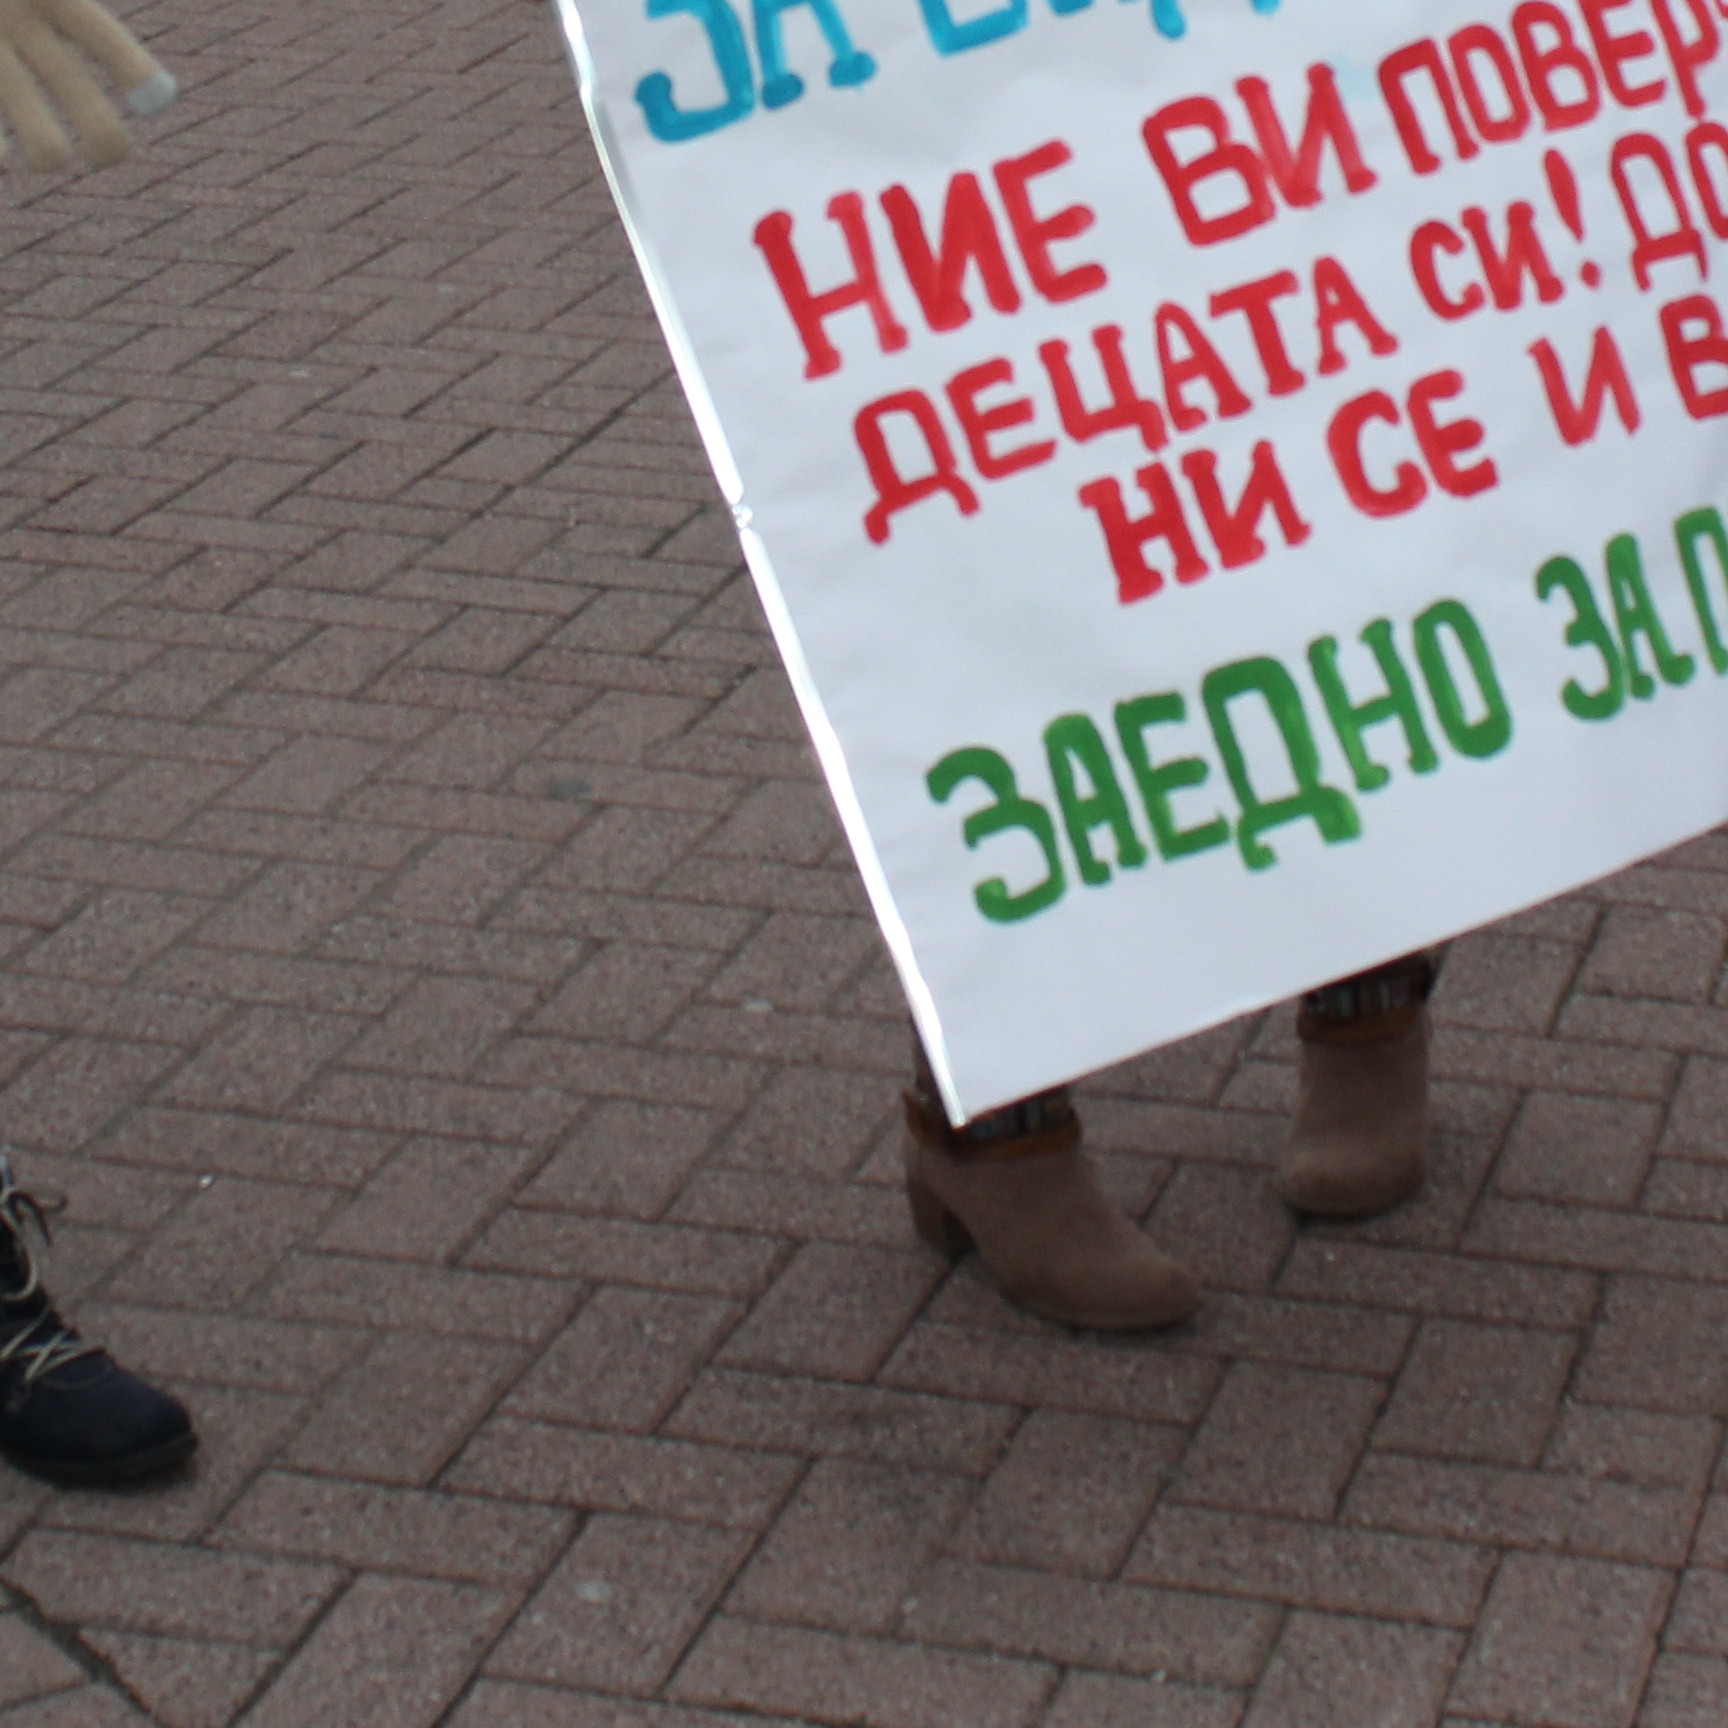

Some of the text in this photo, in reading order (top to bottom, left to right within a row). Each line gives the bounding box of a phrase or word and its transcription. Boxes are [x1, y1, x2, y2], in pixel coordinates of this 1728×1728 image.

[755, 142, 1106, 378] НИЕ
[1143, 62, 1375, 245] ВИ
[855, 258, 1397, 543] ДЕЦАТА
[1411, 150, 1602, 321] СИ!
[1080, 441, 1309, 603] НИ
[1328, 370, 1496, 517] СЕ
[1530, 328, 1638, 446] И
[927, 601, 1512, 922] ЗАЕДНО
[1537, 532, 1694, 720] ЗА
